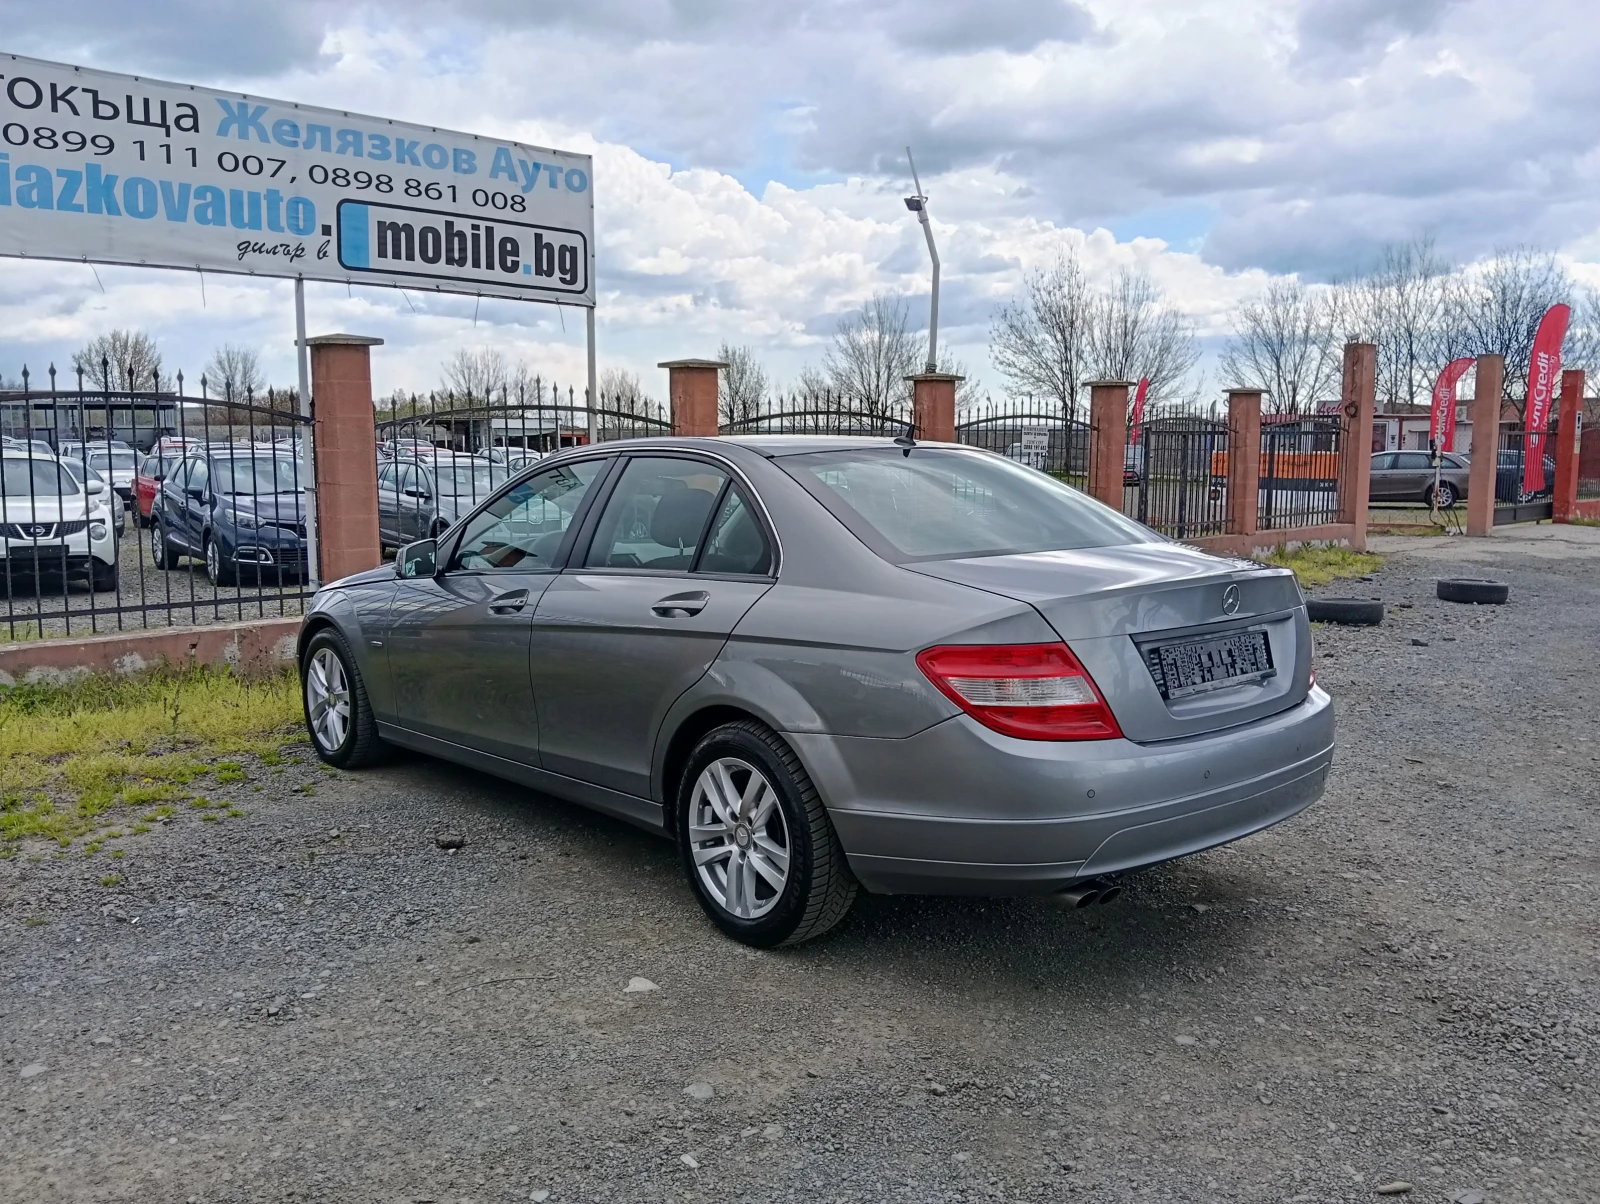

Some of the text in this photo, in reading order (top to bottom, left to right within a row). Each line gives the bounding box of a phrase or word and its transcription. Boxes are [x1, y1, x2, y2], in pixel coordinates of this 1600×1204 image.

[0, 74, 588, 193] окъща Желязков Ауто
[2, 123, 527, 213] 0899 111 007, 0898 861 008
[377, 219, 578, 285] mobile.bg
